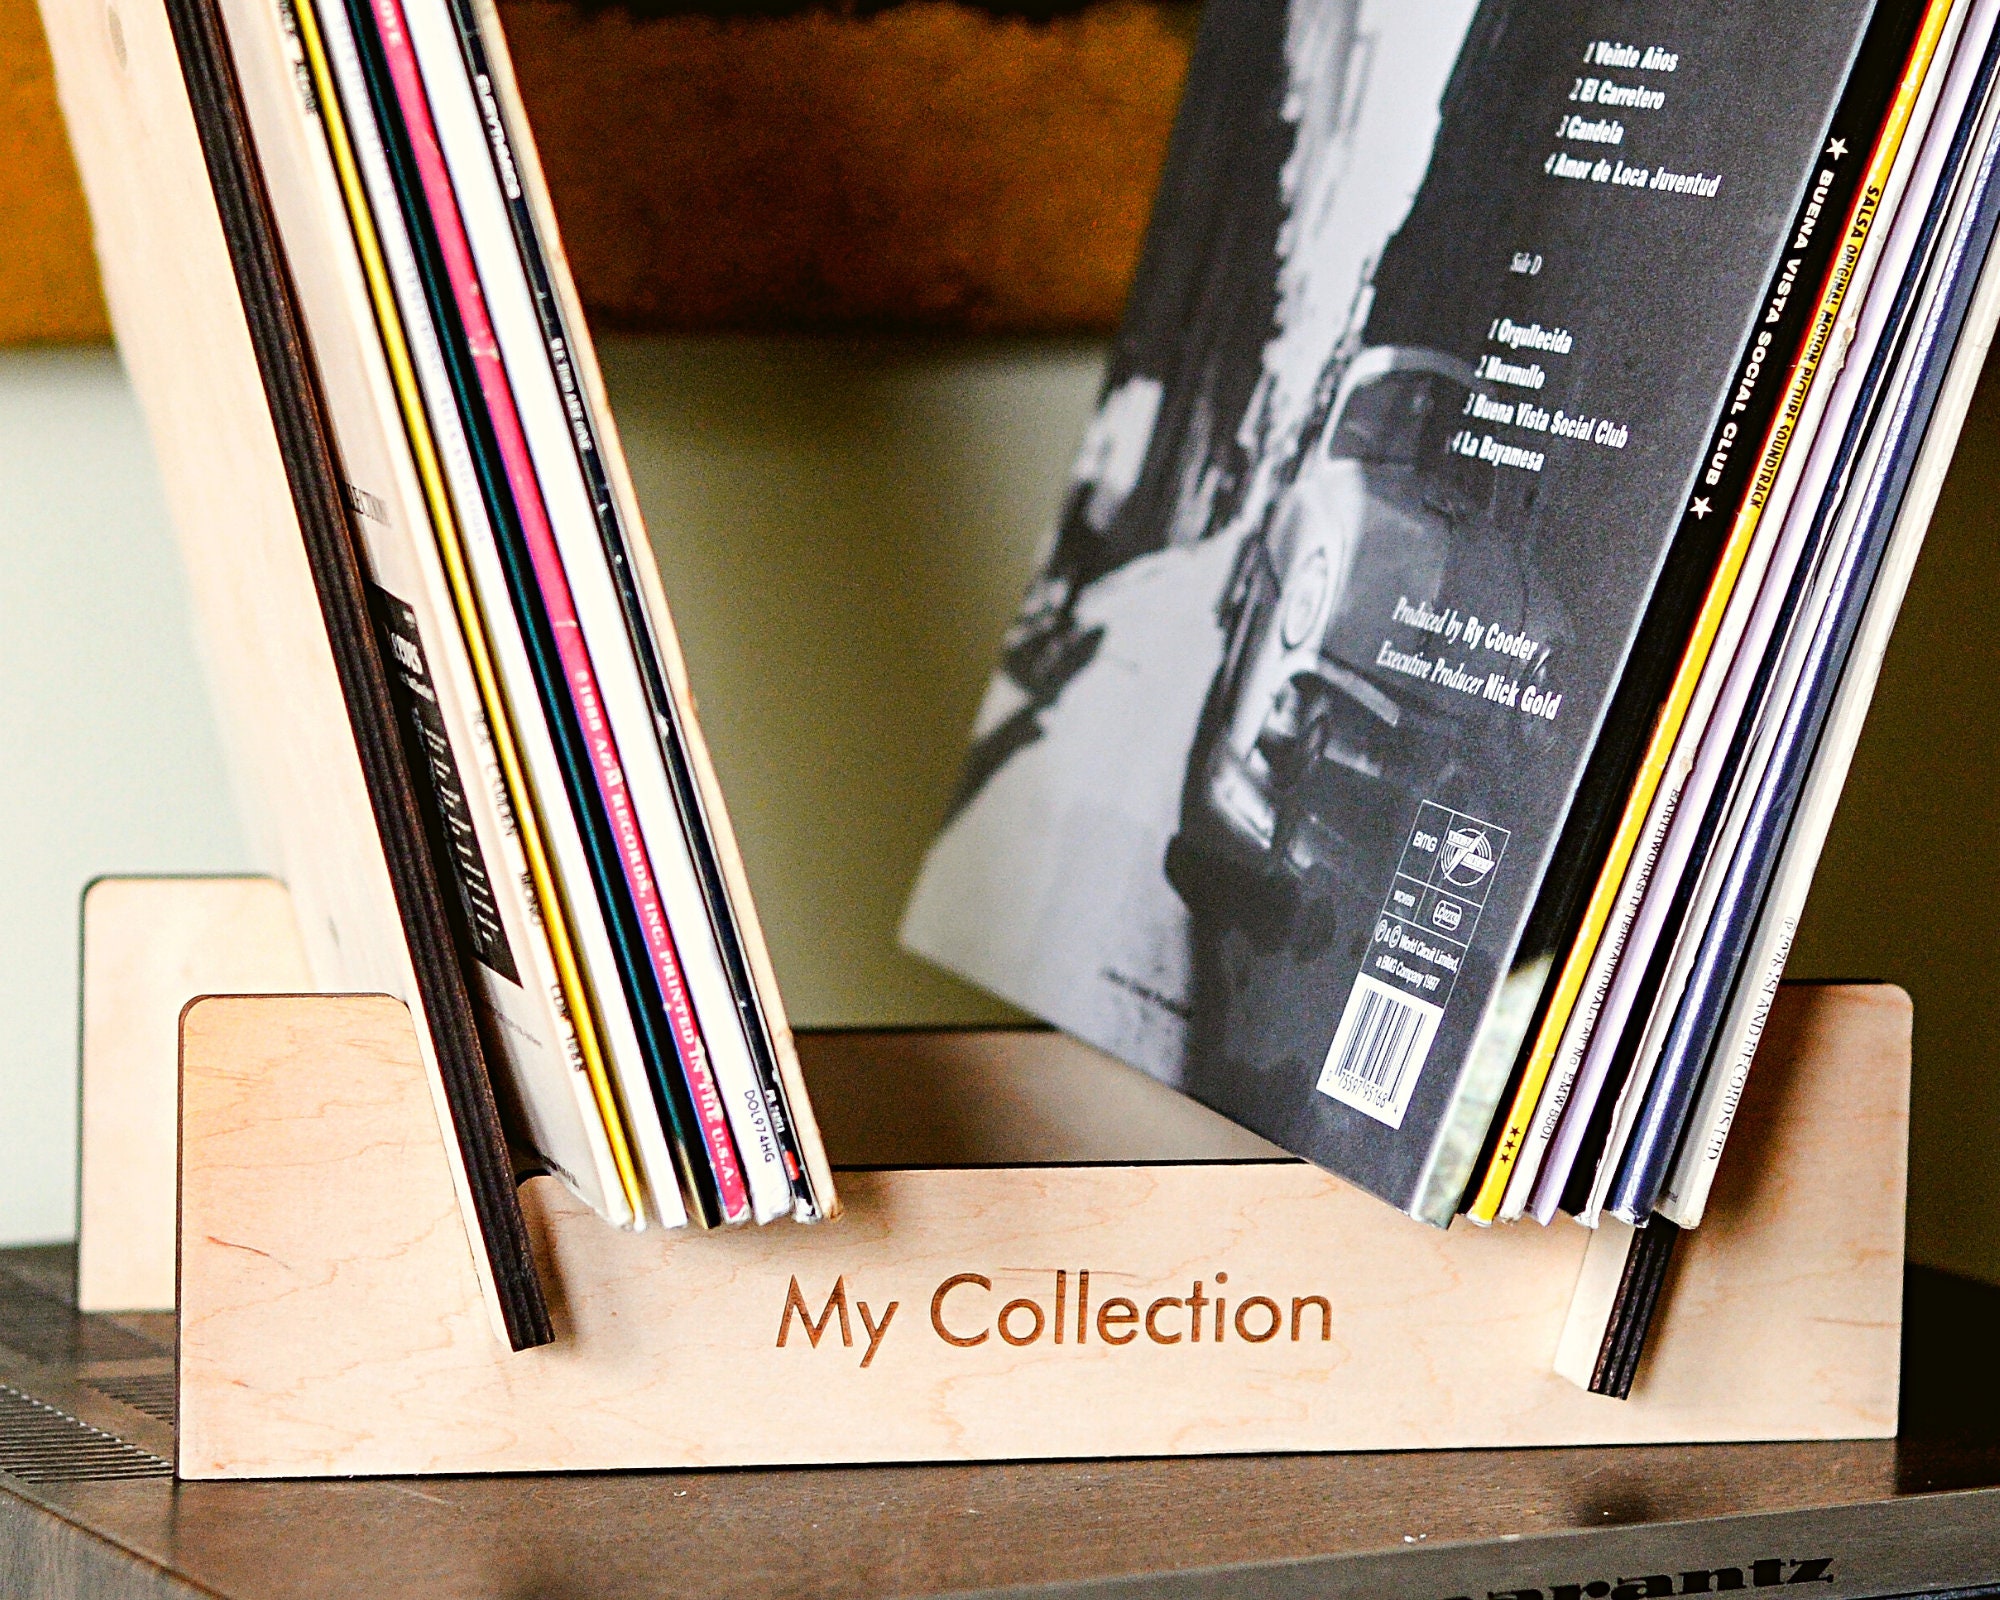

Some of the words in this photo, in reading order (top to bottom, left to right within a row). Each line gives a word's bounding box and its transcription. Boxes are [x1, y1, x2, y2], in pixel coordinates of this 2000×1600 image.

[1595, 42, 1640, 68] Veinte
[1641, 47, 1678, 72] Años
[1581, 79, 1599, 102] El
[1598, 80, 1665, 109] Carretero
[1568, 116, 1625, 144] Candela
[1553, 154, 1592, 179] Amor
[1591, 159, 1611, 183] de
[1612, 161, 1649, 188] Loca
[1649, 167, 1722, 198] Juventud
[1793, 170, 1835, 249] BUENA
[1850, 185, 1880, 238] SALSA
[1765, 258, 1802, 324] VISTA
[1821, 244, 1859, 312] ORIGINAL
[1498, 318, 1573, 354] Orgullecida
[1801, 309, 1833, 368] MOTION
[1485, 355, 1545, 389] Murmullo
[1731, 332, 1773, 416] SOCIAL
[1782, 365, 1812, 420] PICTURE
[1473, 394, 1514, 423] Buena
[1515, 402, 1550, 432] Vista
[1550, 410, 1595, 441] Social
[1595, 420, 1628, 449] Club
[1460, 431, 1480, 457] La
[1479, 435, 1545, 472] Bayamesa
[1705, 423, 1740, 486] CLUB
[1748, 420, 1792, 509] SOUNDTRACK
[1392, 596, 1450, 633] Produced
[1445, 610, 1463, 644] by
[1462, 616, 1484, 650] Ry
[1484, 622, 1539, 661] Cooder
[1376, 640, 1434, 678] Executive
[1430, 658, 1484, 695] Producer
[1482, 673, 1520, 708] Nick
[1520, 684, 1562, 720] Gold
[1634, 788, 1681, 892] EARTHWORKS
[608, 792, 654, 898] RECORDS,
[643, 901, 668, 946] INC.
[656, 949, 696, 1045] PRINTED
[685, 1047, 705, 1075] IN
[708, 1126, 738, 1187] U.S.A.
[1552, 1070, 1573, 1107] EMW
[1538, 1107, 1559, 1141] 5501
[775, 1273, 899, 1368] My
[930, 1269, 1332, 1348] Collection
[1443, 1557, 1834, 1600] rantz
